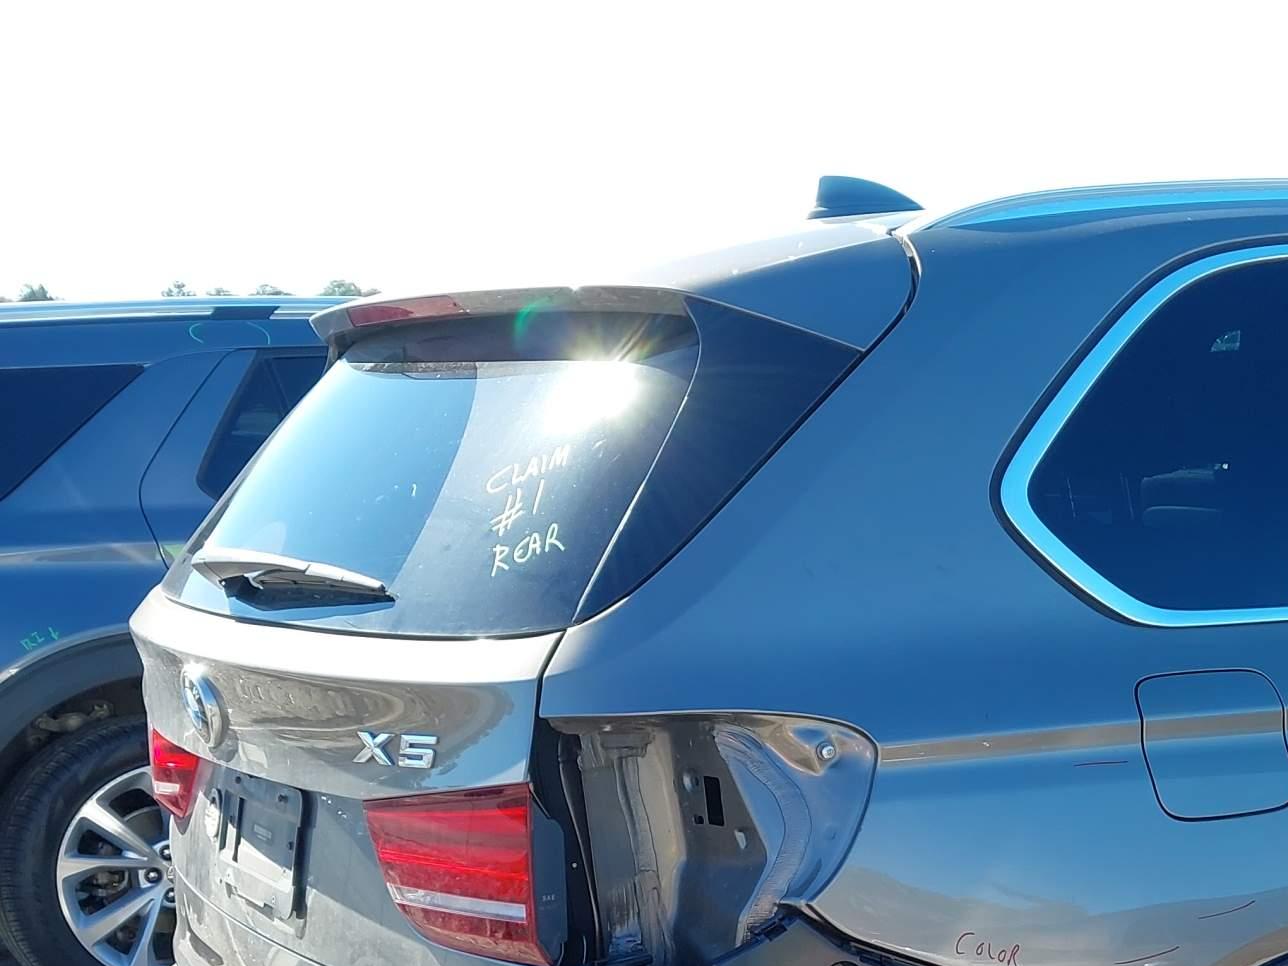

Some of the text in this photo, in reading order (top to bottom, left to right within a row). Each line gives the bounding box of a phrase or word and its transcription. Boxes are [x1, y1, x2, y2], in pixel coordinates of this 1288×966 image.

[486, 444, 571, 493] CLAIM
[490, 479, 545, 537] #1
[491, 523, 565, 577] REAR
[352, 731, 439, 769] X5
